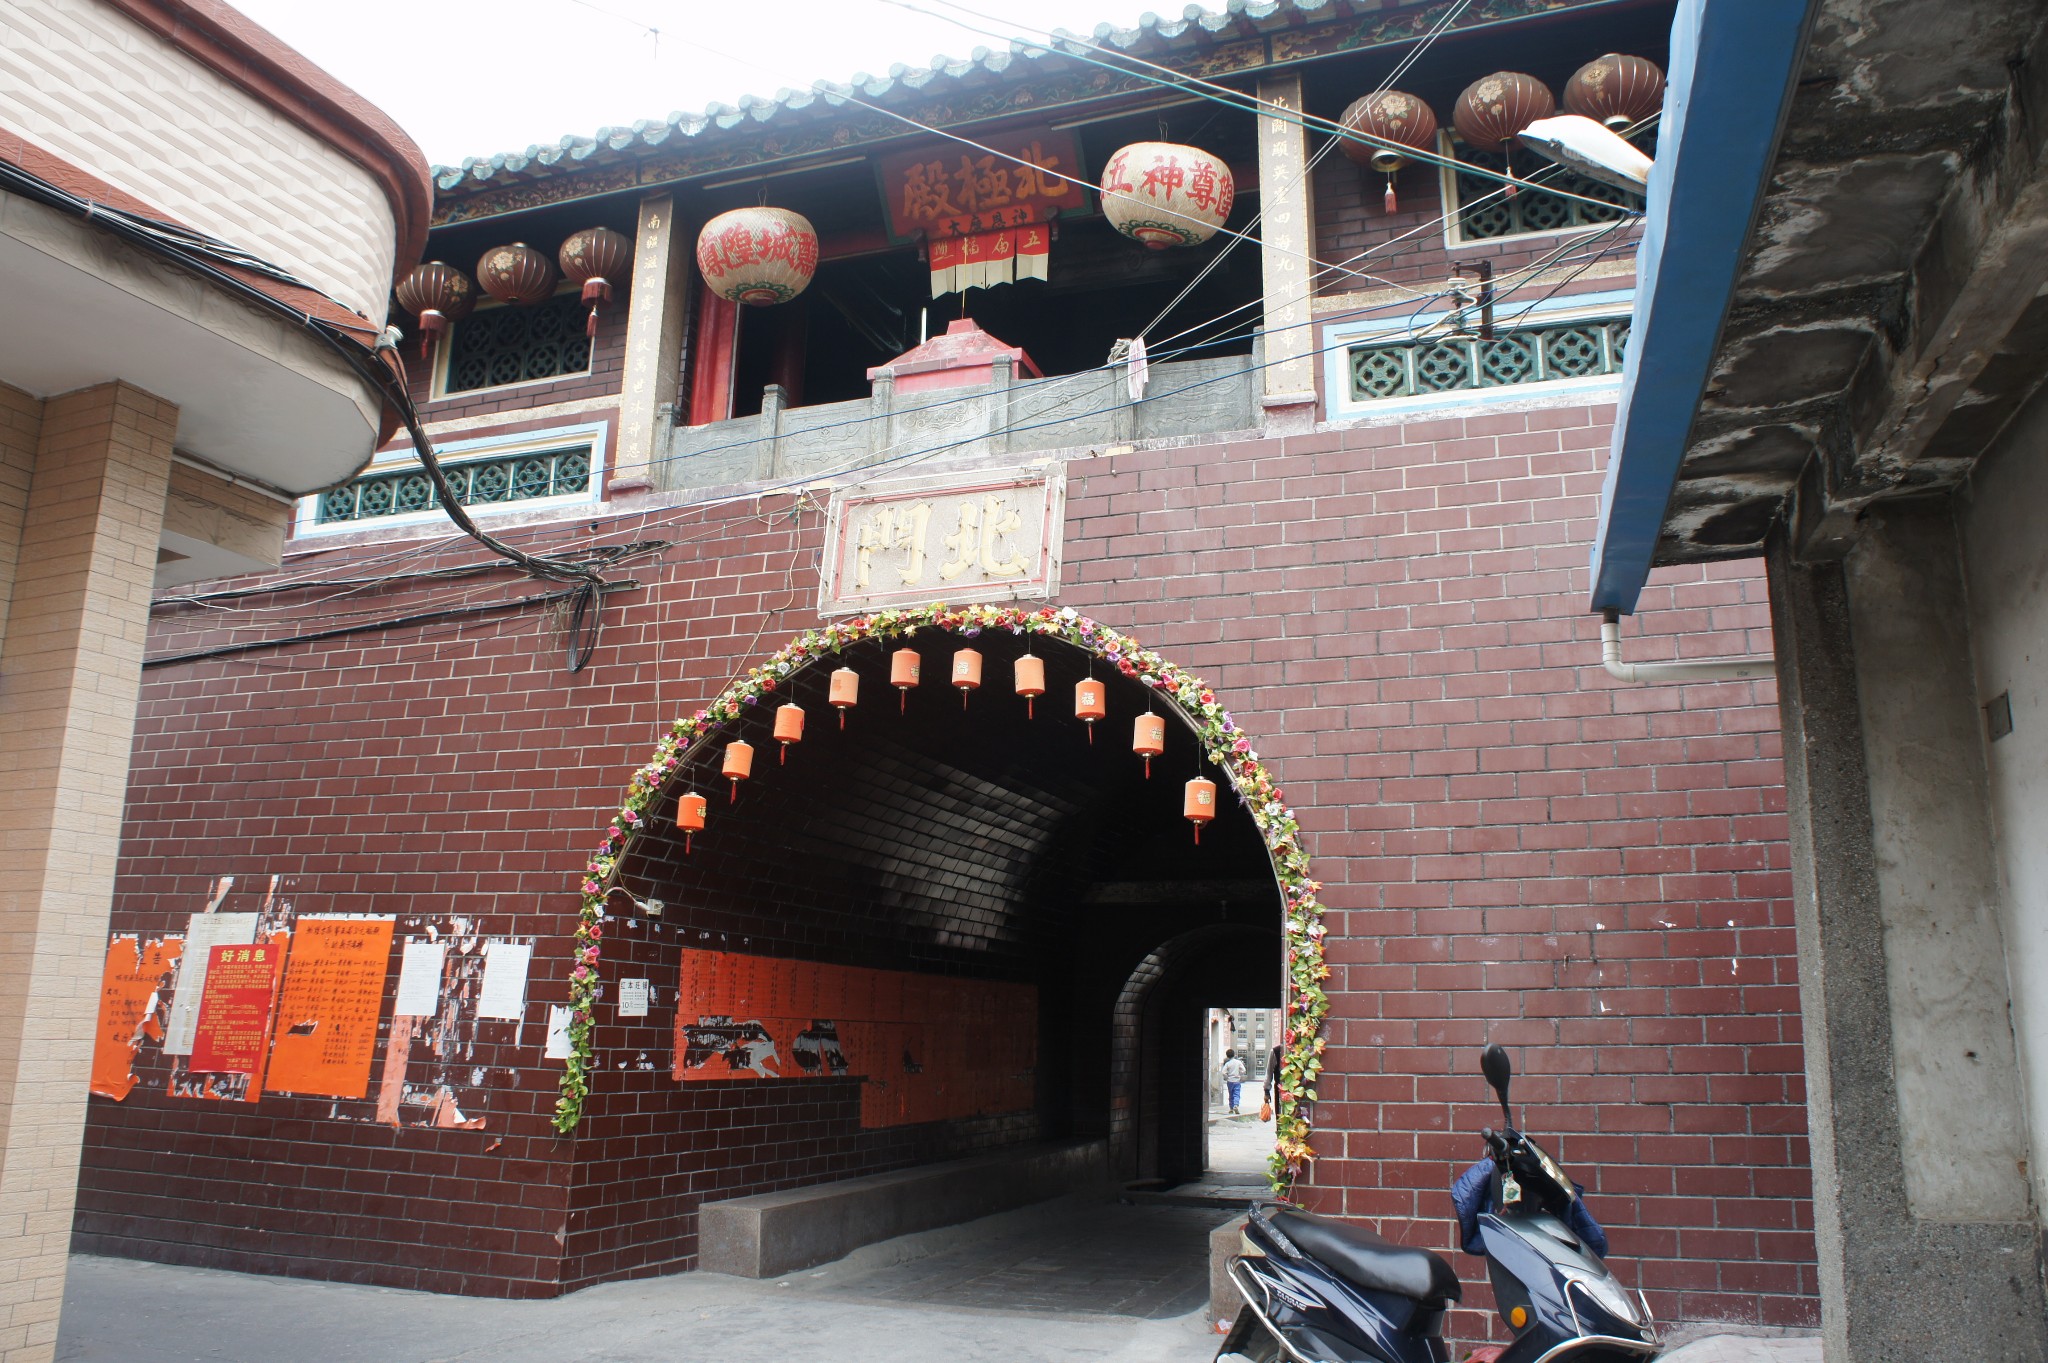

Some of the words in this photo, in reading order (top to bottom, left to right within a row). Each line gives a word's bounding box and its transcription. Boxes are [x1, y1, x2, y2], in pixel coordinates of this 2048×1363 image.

[903, 141, 1068, 220] 北極殿
[854, 495, 1030, 587] 北門
[220, 948, 266, 963] 好消息
